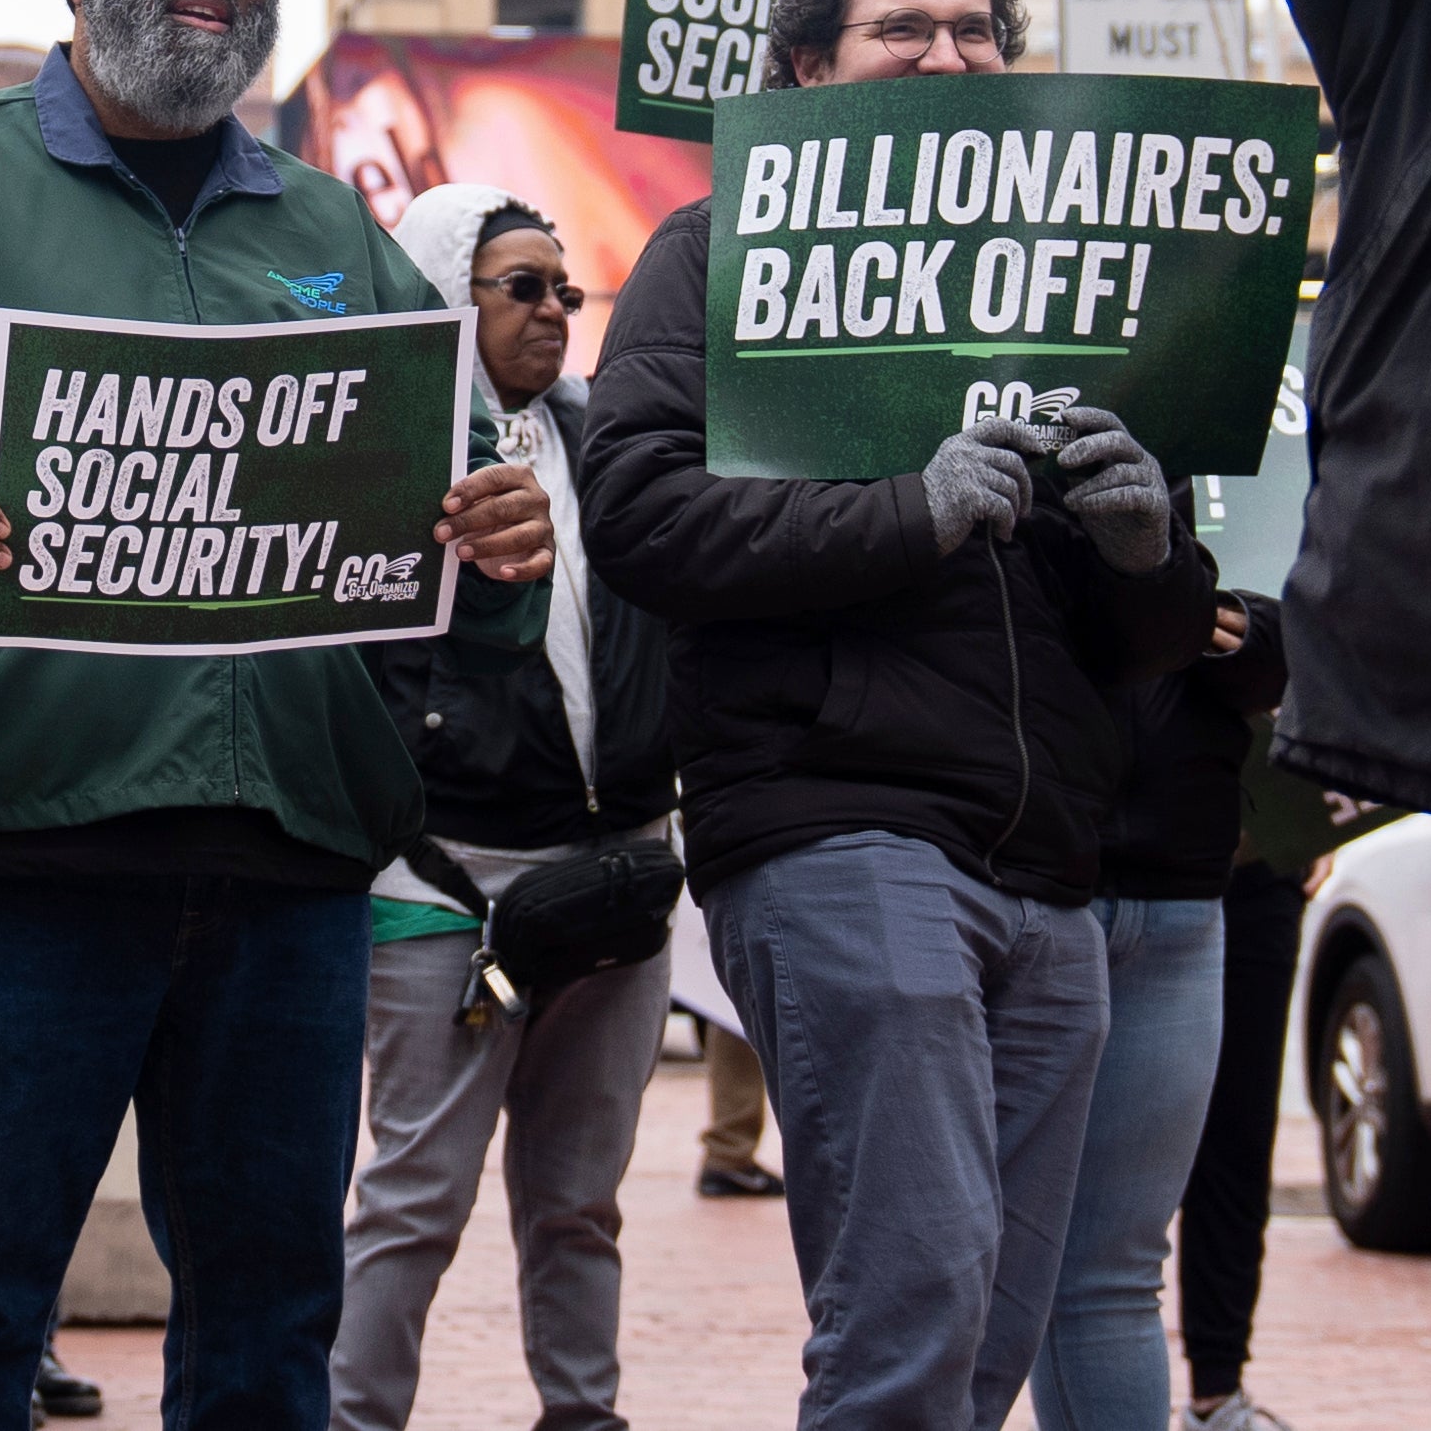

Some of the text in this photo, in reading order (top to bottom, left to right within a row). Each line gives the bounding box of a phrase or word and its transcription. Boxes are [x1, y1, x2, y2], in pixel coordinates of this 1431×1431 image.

[1108, 22, 1199, 59] MUST
[735, 129, 1291, 237] BILLIONAIRES:
[734, 236, 1153, 342] BACK OFF!
[32, 367, 368, 450] HANDS OFF
[25, 445, 241, 523] SOCIAL
[18, 519, 339, 597] SECURITY!
[348, 579, 420, 598] GET ORGANIZED
[379, 591, 418, 602] AFSCME
